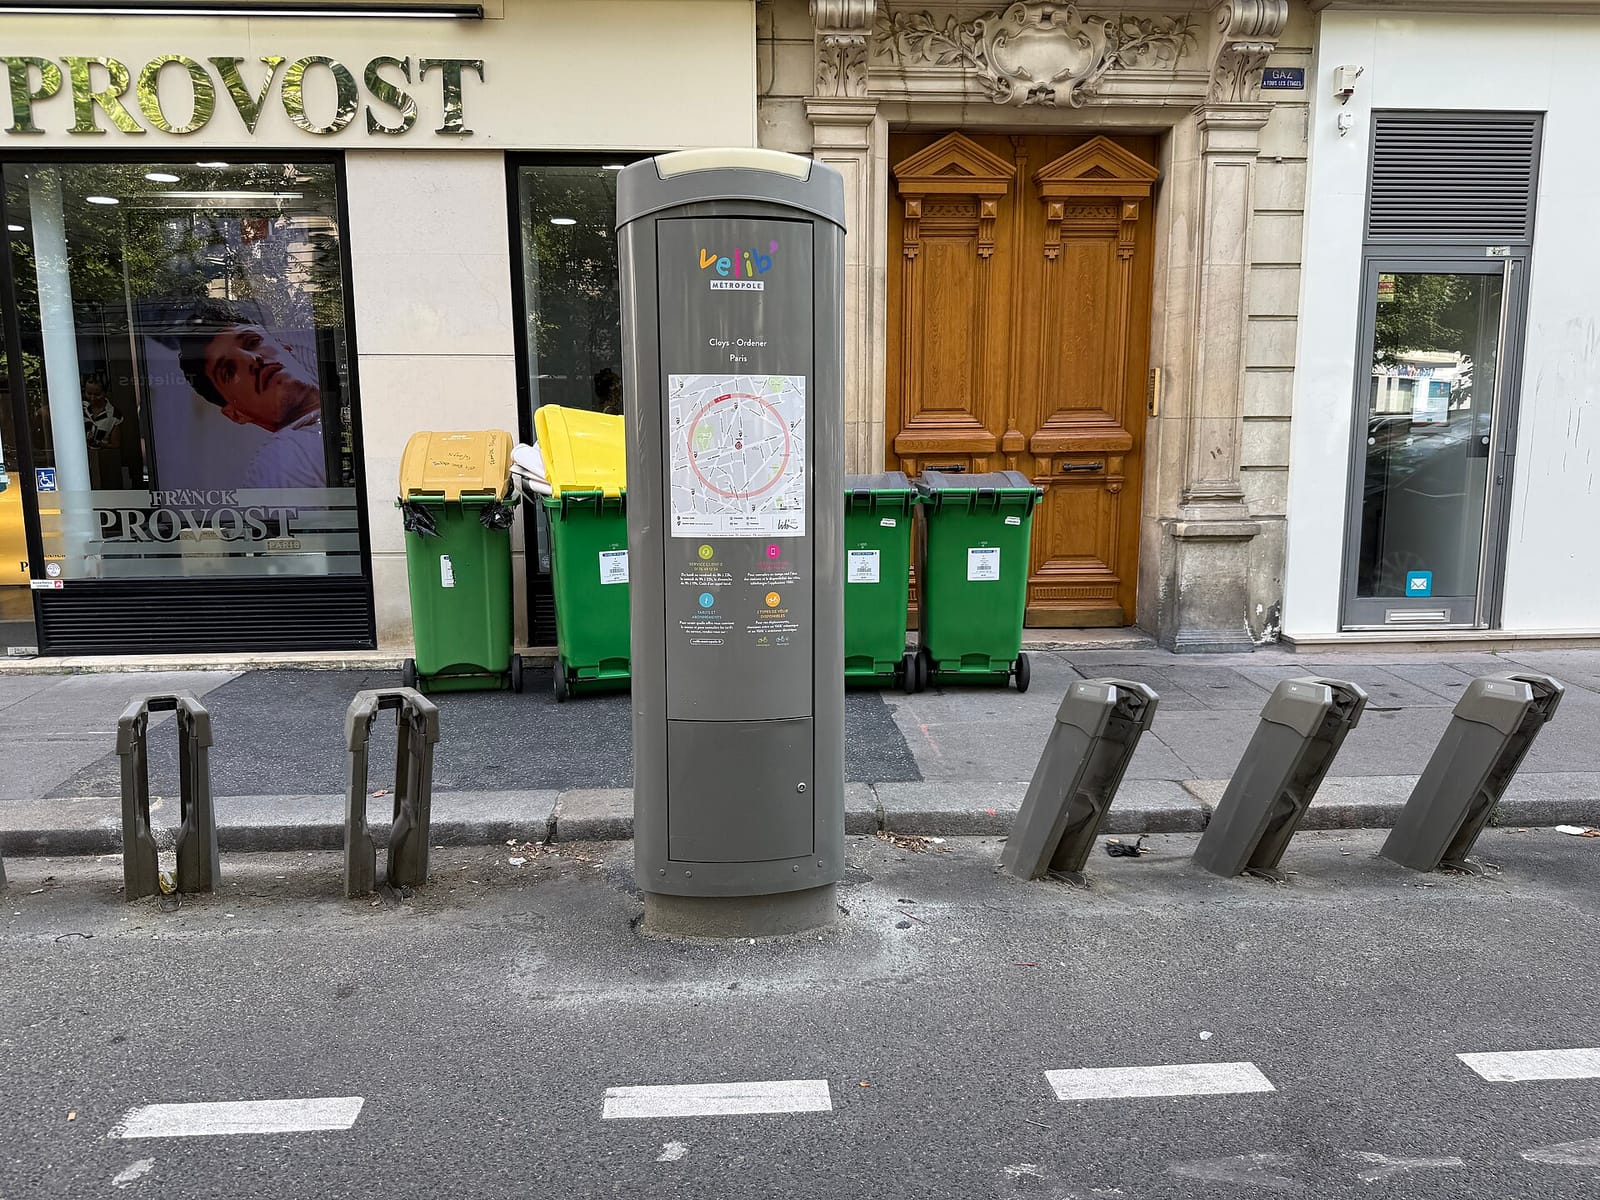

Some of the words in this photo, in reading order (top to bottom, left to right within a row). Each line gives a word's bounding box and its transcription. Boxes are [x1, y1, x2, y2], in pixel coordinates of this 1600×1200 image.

[1272, 70, 1293, 79] GAZ
[0, 55, 485, 136] PROVOST
[709, 338, 730, 348] Cloys
[736, 338, 768, 347] Ordener
[729, 354, 748, 363] Paris
[152, 489, 237, 506] FRANCK
[94, 506, 297, 542] PROVOST
[269, 542, 300, 550] PARIS
